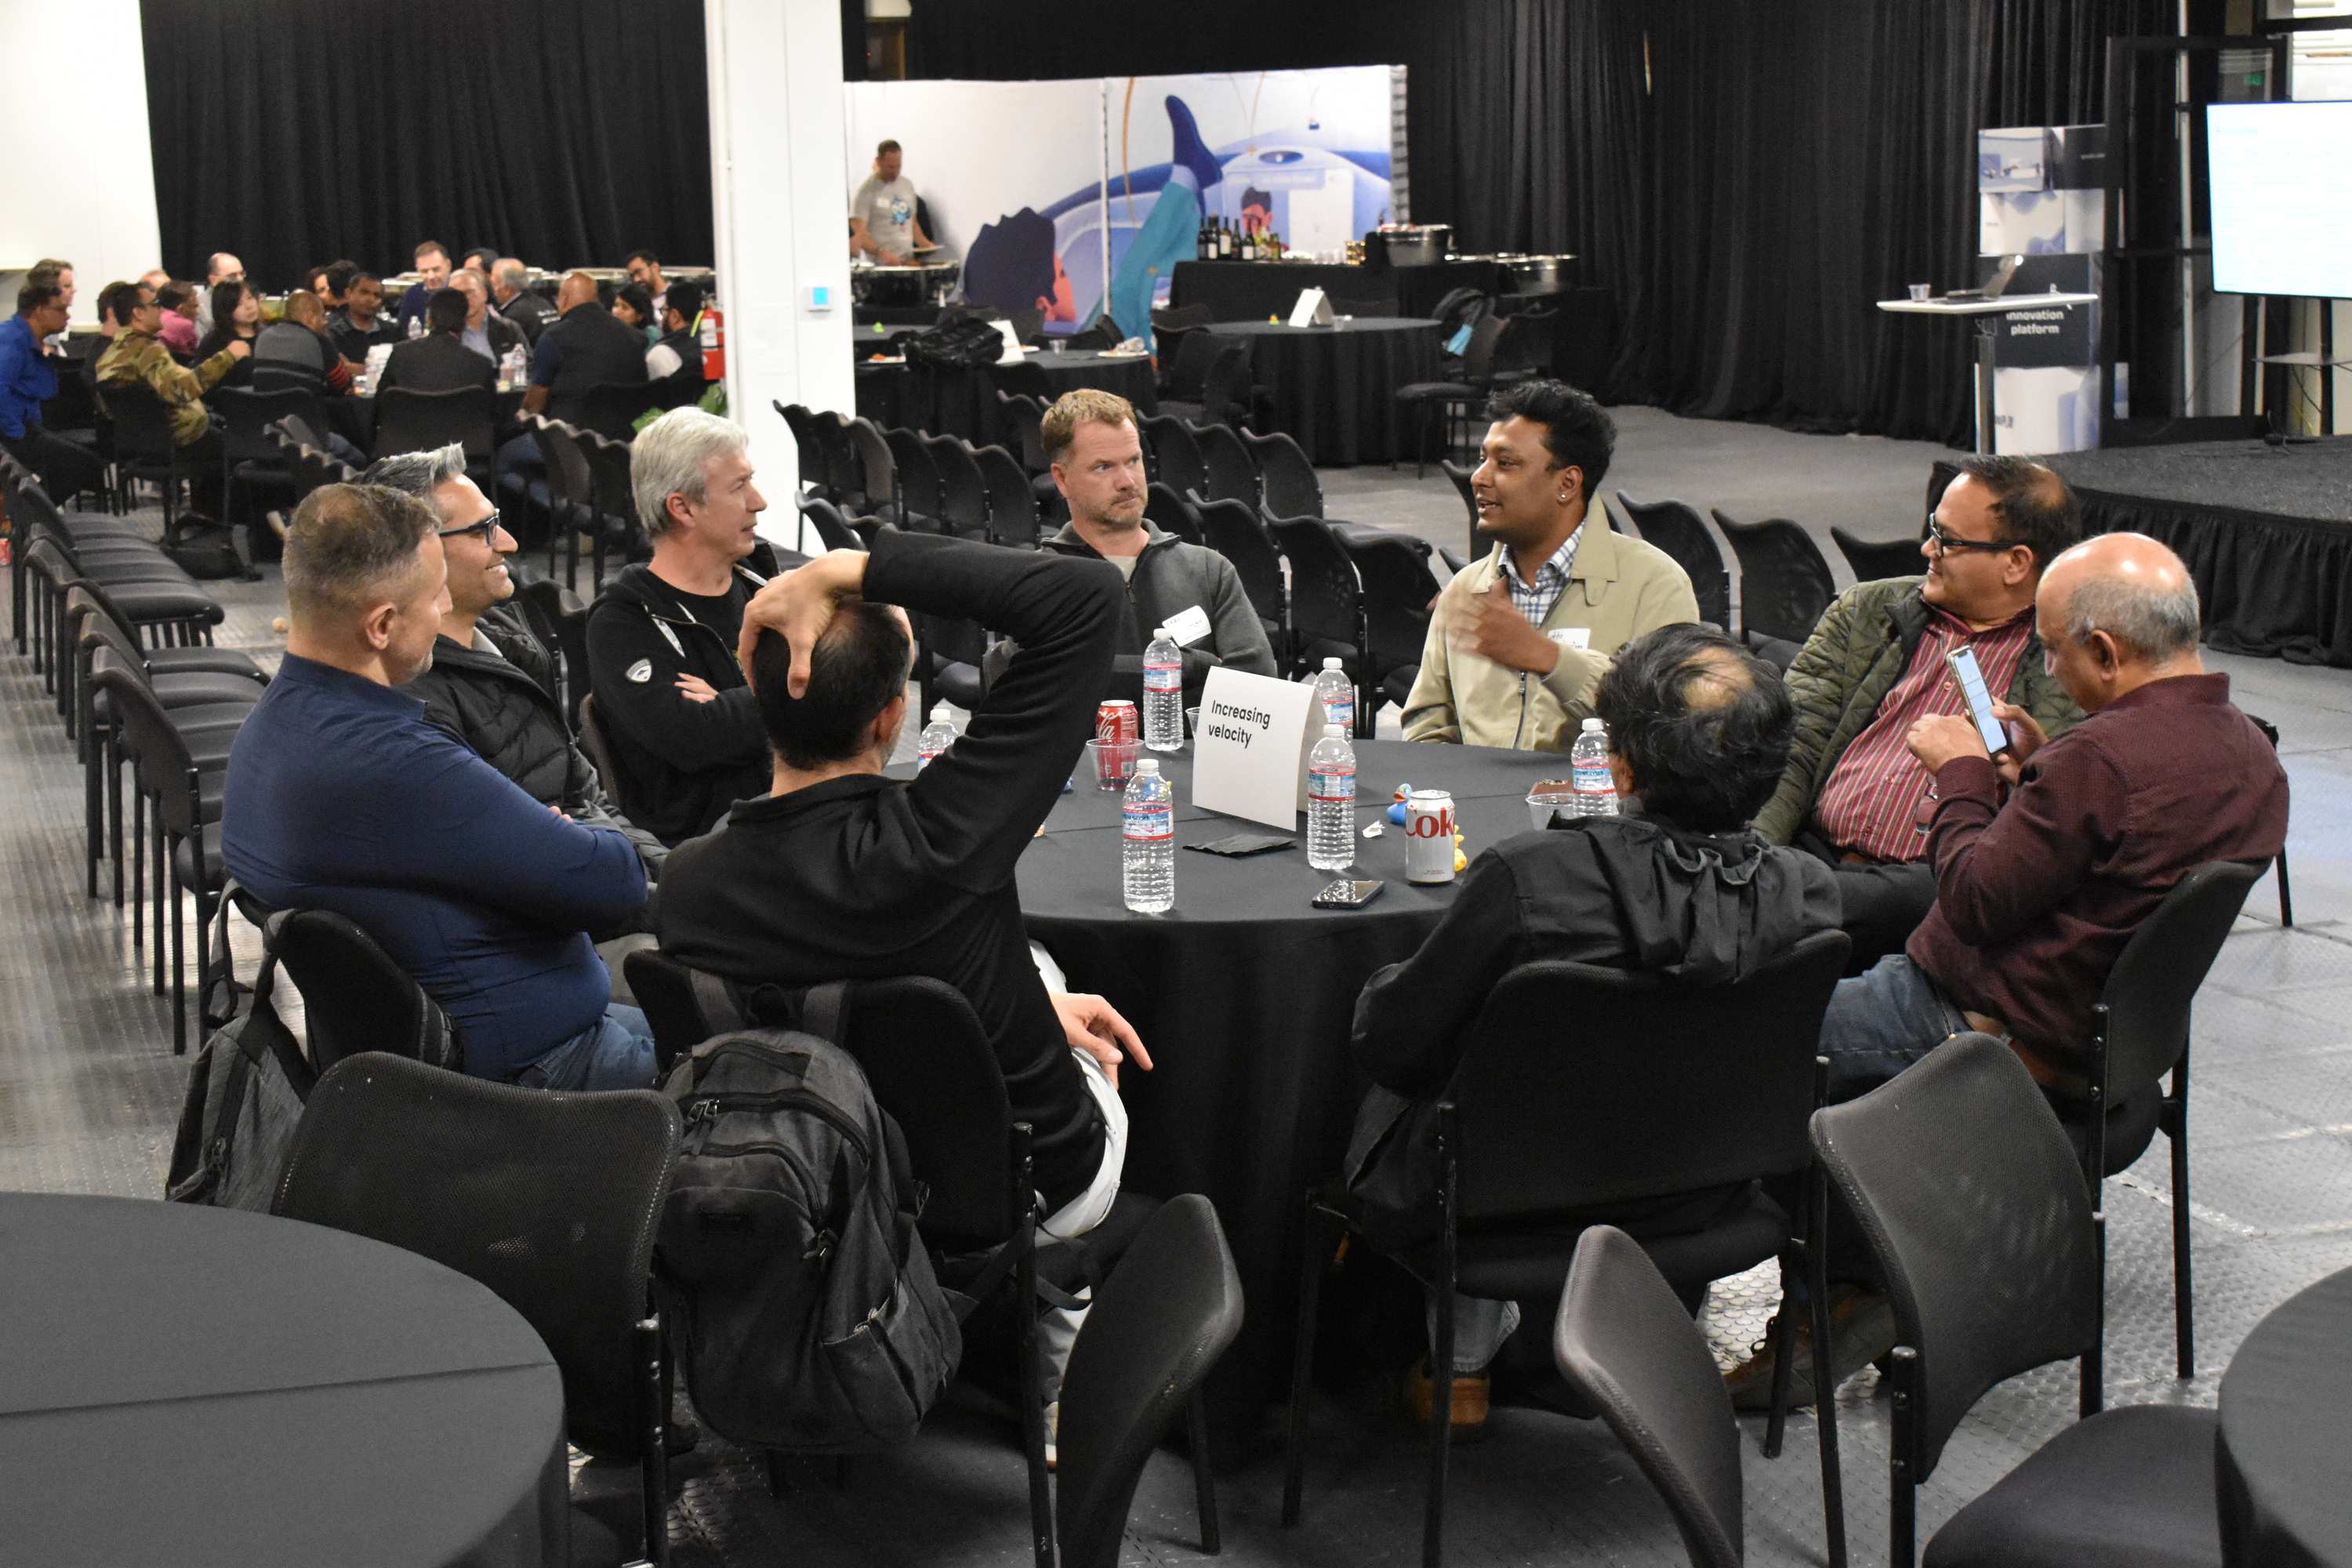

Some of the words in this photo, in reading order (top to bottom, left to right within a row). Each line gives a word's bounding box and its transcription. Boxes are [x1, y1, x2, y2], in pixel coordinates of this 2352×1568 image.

[2005, 310, 2064, 321] innovation
[2010, 324, 2060, 336] platform
[1211, 699, 1271, 730] Increasing
[1208, 724, 1253, 749] velocity
